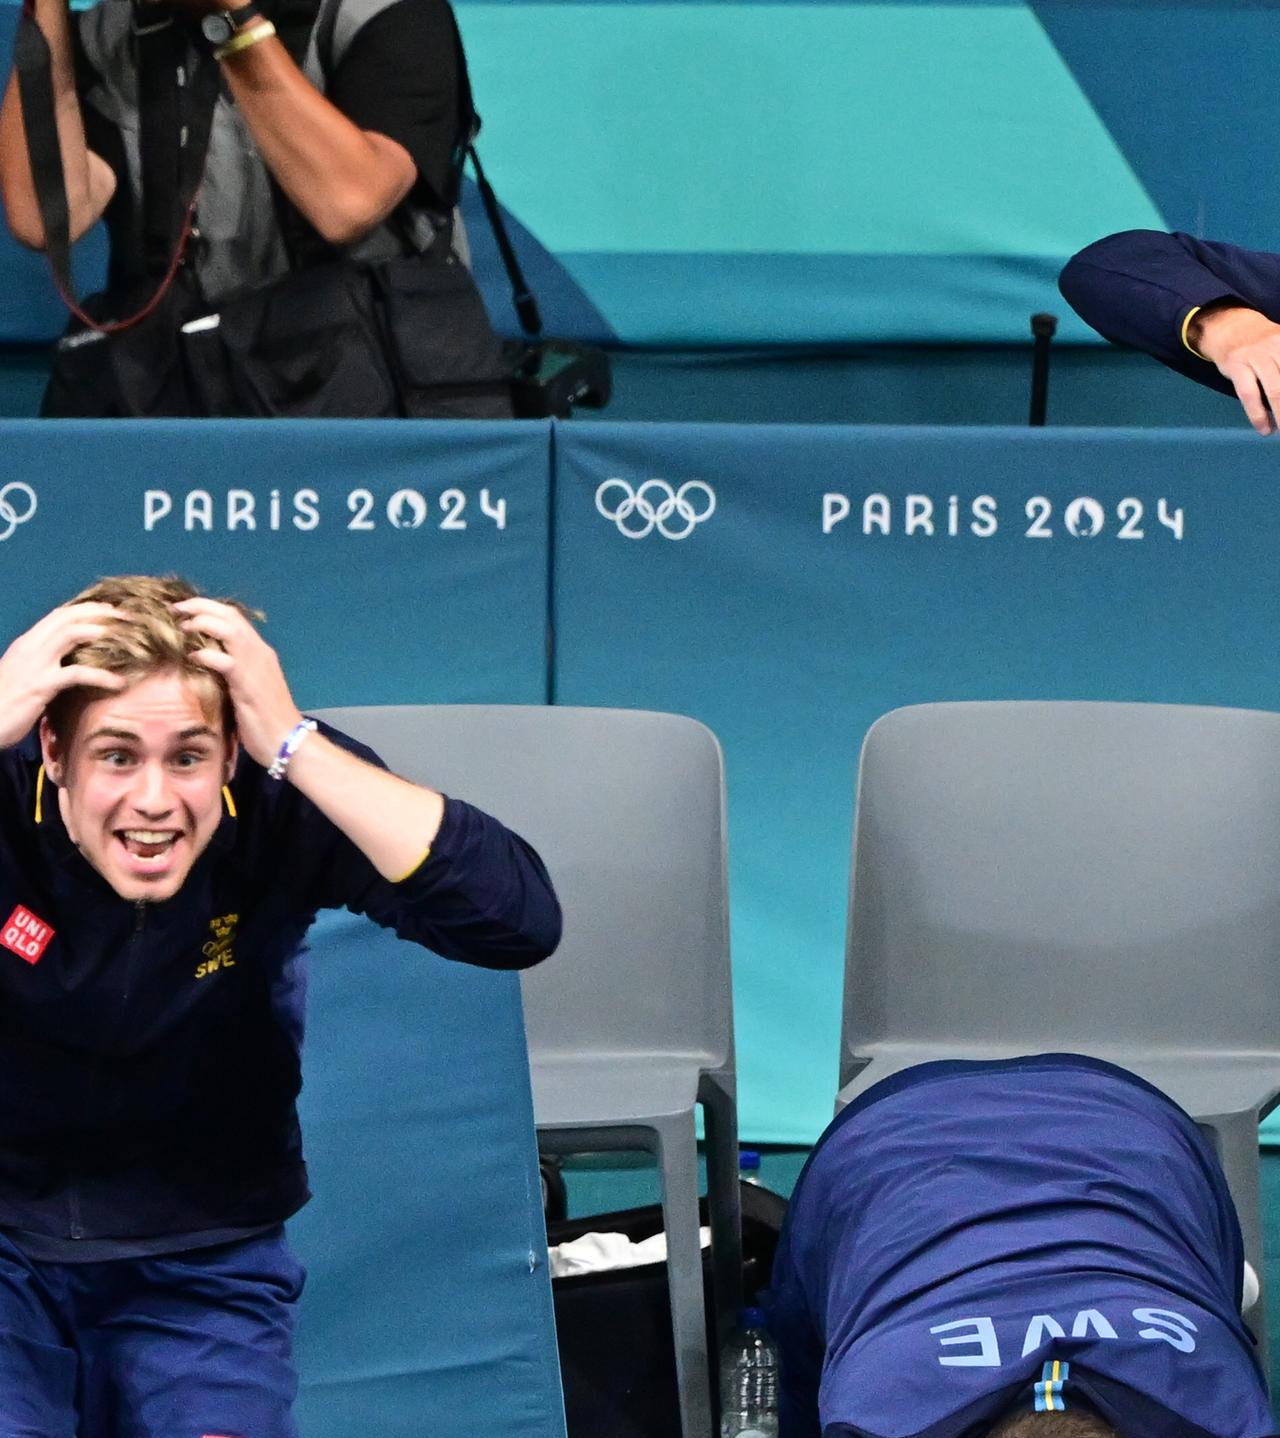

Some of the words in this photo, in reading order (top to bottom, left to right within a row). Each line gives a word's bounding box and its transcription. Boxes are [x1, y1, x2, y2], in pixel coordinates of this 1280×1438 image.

[14, 911, 47, 942] UNI
[4, 927, 40, 957] QLO
[195, 948, 236, 978] SWE
[930, 1307, 1199, 1367] SWE
